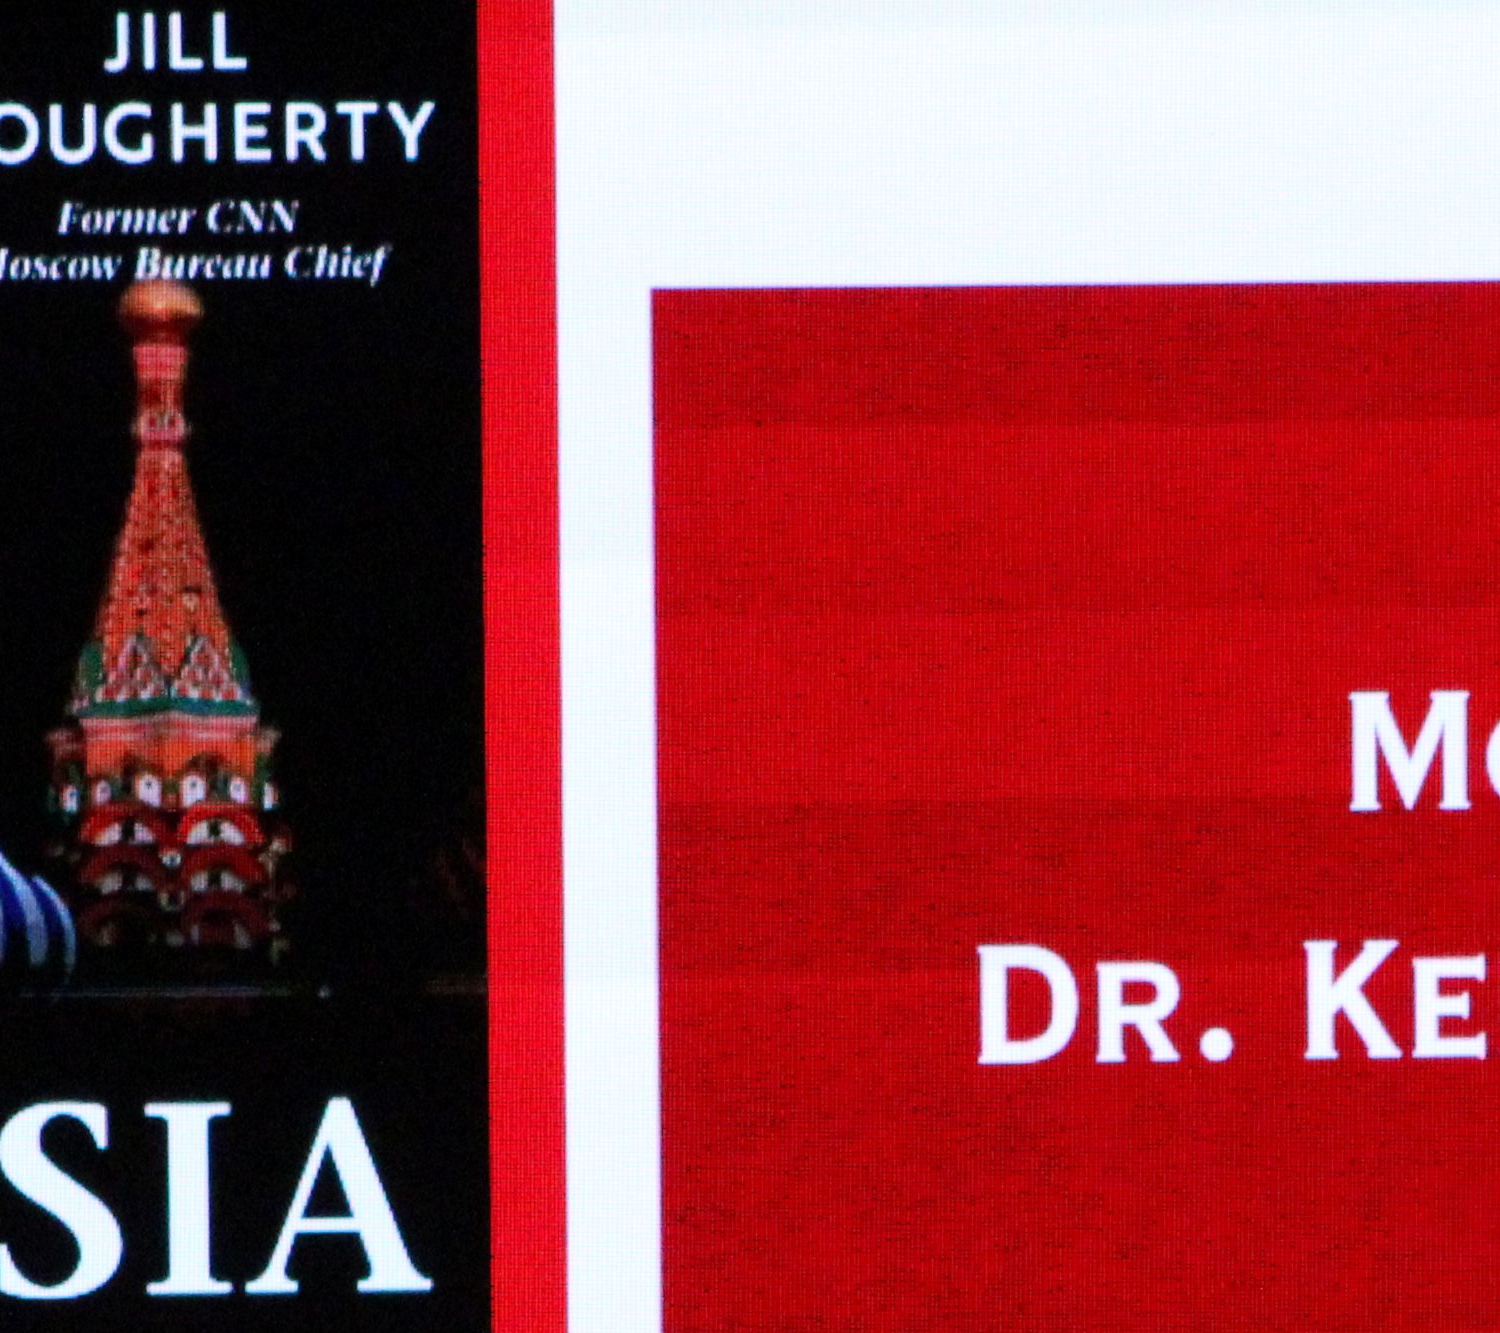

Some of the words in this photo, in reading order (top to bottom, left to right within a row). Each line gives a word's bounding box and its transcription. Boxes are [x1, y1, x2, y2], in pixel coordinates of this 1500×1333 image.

[104, 12, 247, 72] JILL
[59, 201, 196, 234] Former
[207, 200, 298, 232] CNN
[135, 247, 270, 279] Bureau
[284, 243, 392, 286] Chief
[977, 944, 1233, 1064] DR.
